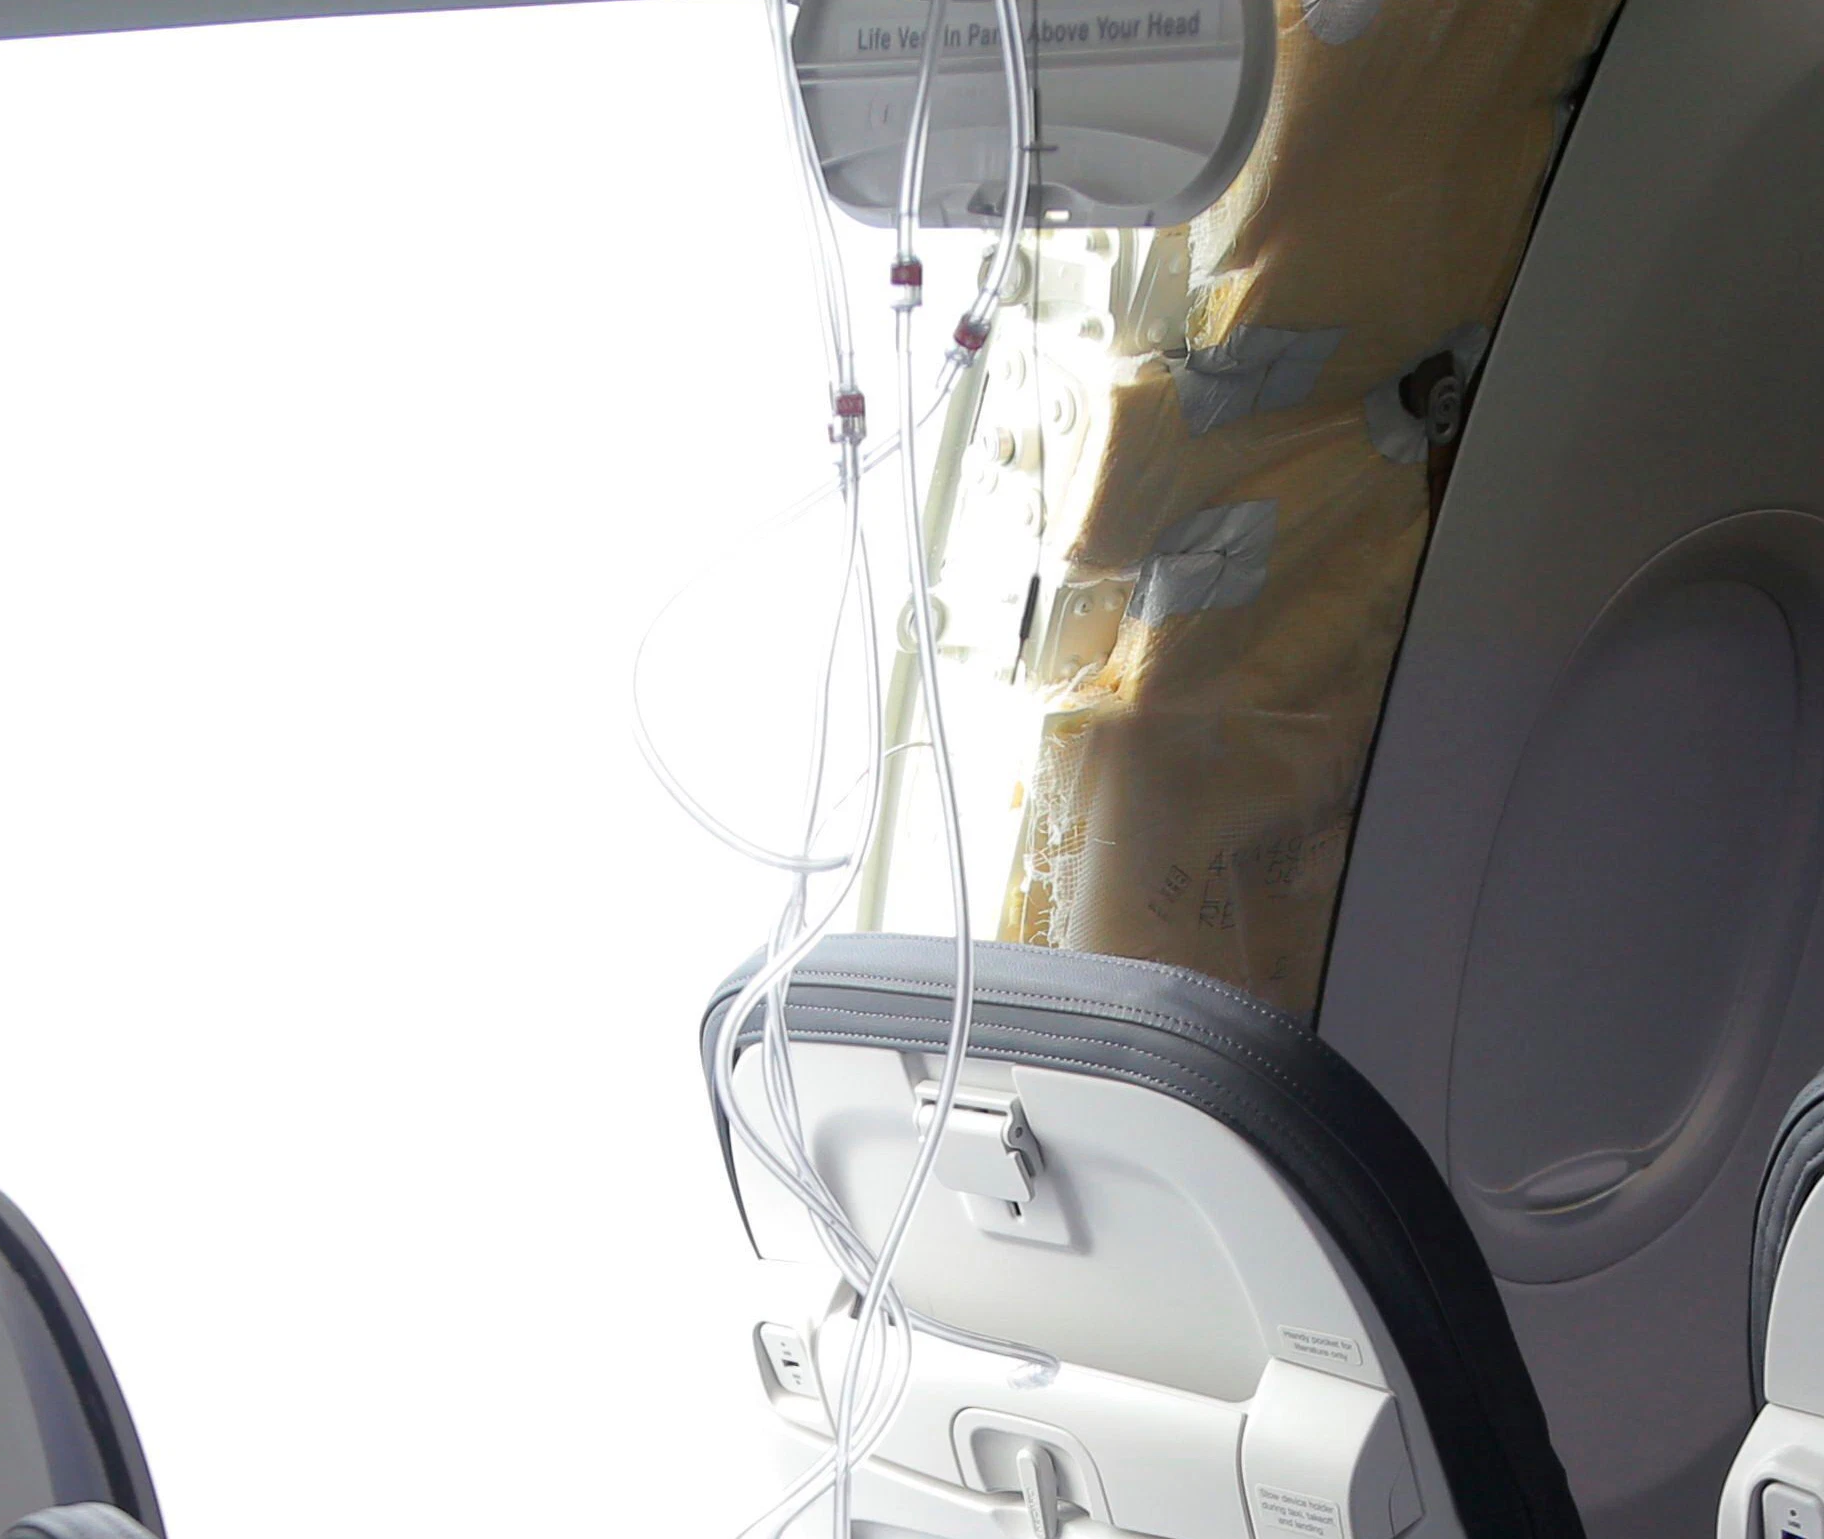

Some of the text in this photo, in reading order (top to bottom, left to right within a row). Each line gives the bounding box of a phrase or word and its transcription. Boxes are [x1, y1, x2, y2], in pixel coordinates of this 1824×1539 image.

[858, 27, 891, 50] Life
[943, 24, 960, 47] In
[1028, 19, 1090, 43] Above
[1096, 14, 1141, 41] Your
[1147, 9, 1199, 39] Head
